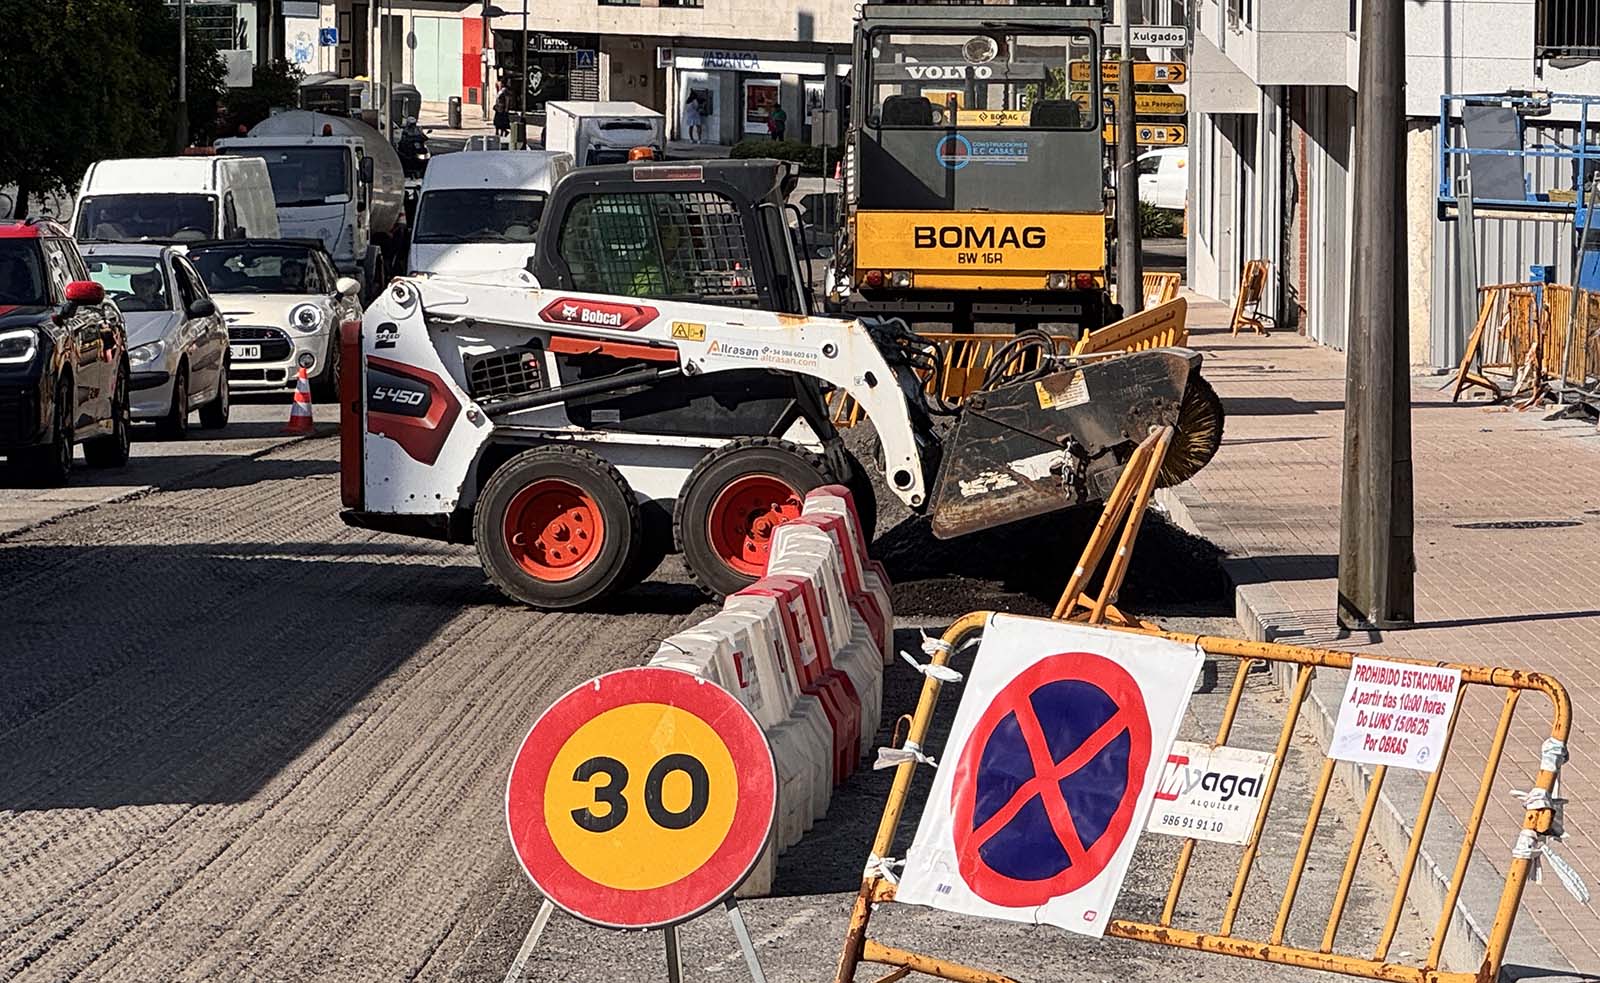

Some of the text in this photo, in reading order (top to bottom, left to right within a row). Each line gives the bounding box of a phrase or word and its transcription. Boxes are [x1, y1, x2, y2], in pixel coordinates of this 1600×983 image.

[1133, 32, 1184, 42] Xulgados
[704, 51, 760, 69] ABANCA
[914, 226, 1046, 248] BOMAG
[958, 253, 1003, 264] BW 16R
[581, 308, 622, 326] Bobcat
[761, 354, 817, 367] altrasan.com
[373, 386, 424, 406] S450
[1354, 664, 1455, 693] PROHIBIDO ESTACIONAR
[1349, 687, 1446, 715] A partir das 10:00 horas
[1356, 710, 1429, 736] Do LUNS 15/06/26
[1363, 733, 1378, 752] Por
[1378, 735, 1408, 755] OBRAS
[571, 753, 709, 833] 30
[1191, 799, 1240, 811] ALQUILER
[1162, 814, 1223, 832] 986 91 91 10
